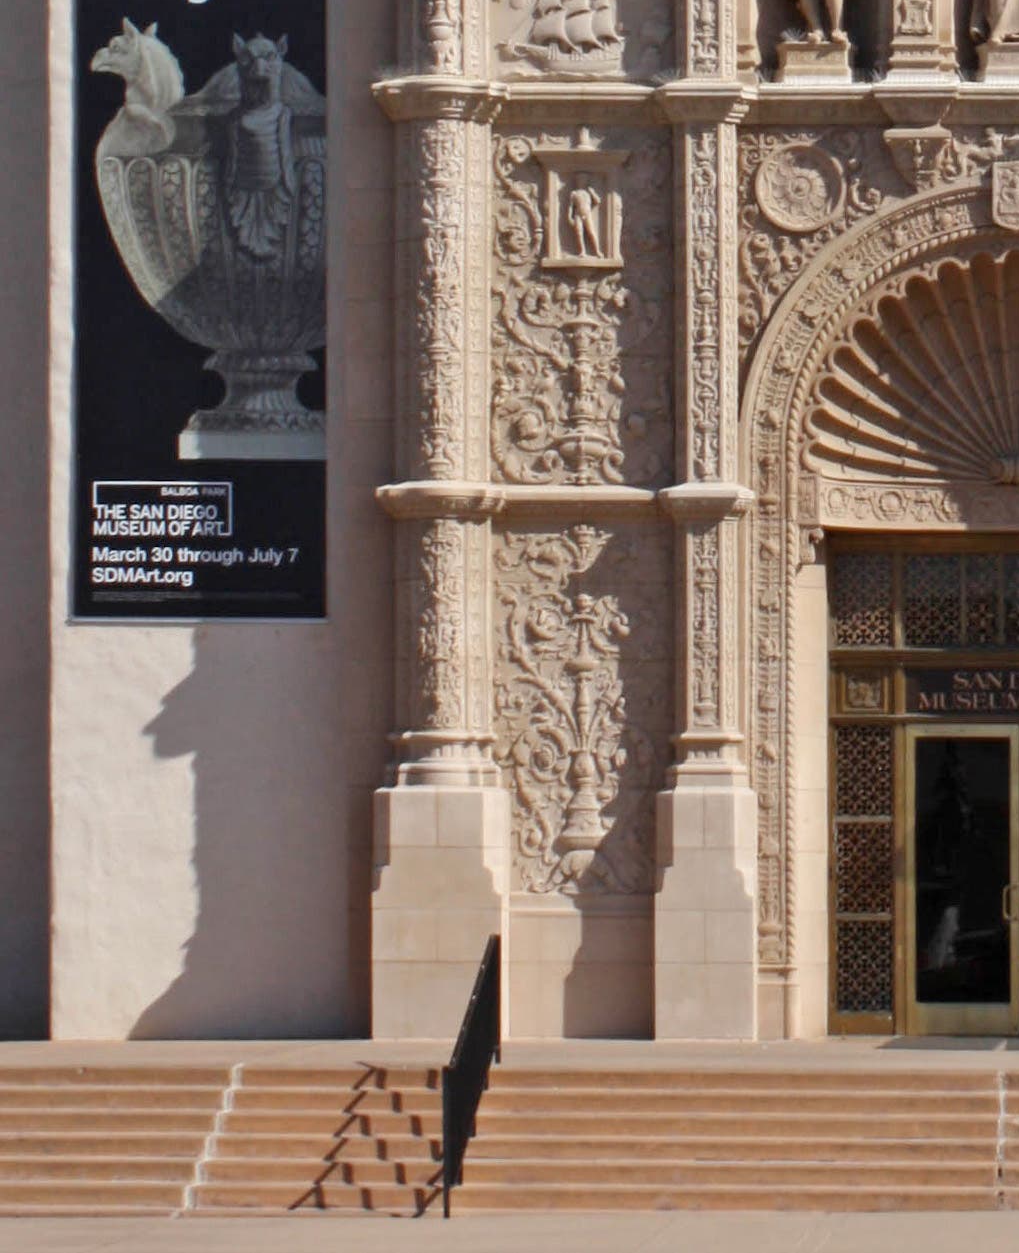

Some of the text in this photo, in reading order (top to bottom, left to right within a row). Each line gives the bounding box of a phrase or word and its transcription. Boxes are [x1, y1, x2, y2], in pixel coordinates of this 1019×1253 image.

[161, 487, 199, 496] BALBOA
[95, 504, 217, 520] THE SAN DIEGO
[94, 521, 226, 536] MUSEUM OF ART
[92, 547, 299, 566] March 30 through July 7
[93, 568, 193, 586] SDMArt.org
[953, 671, 1002, 689] SAN
